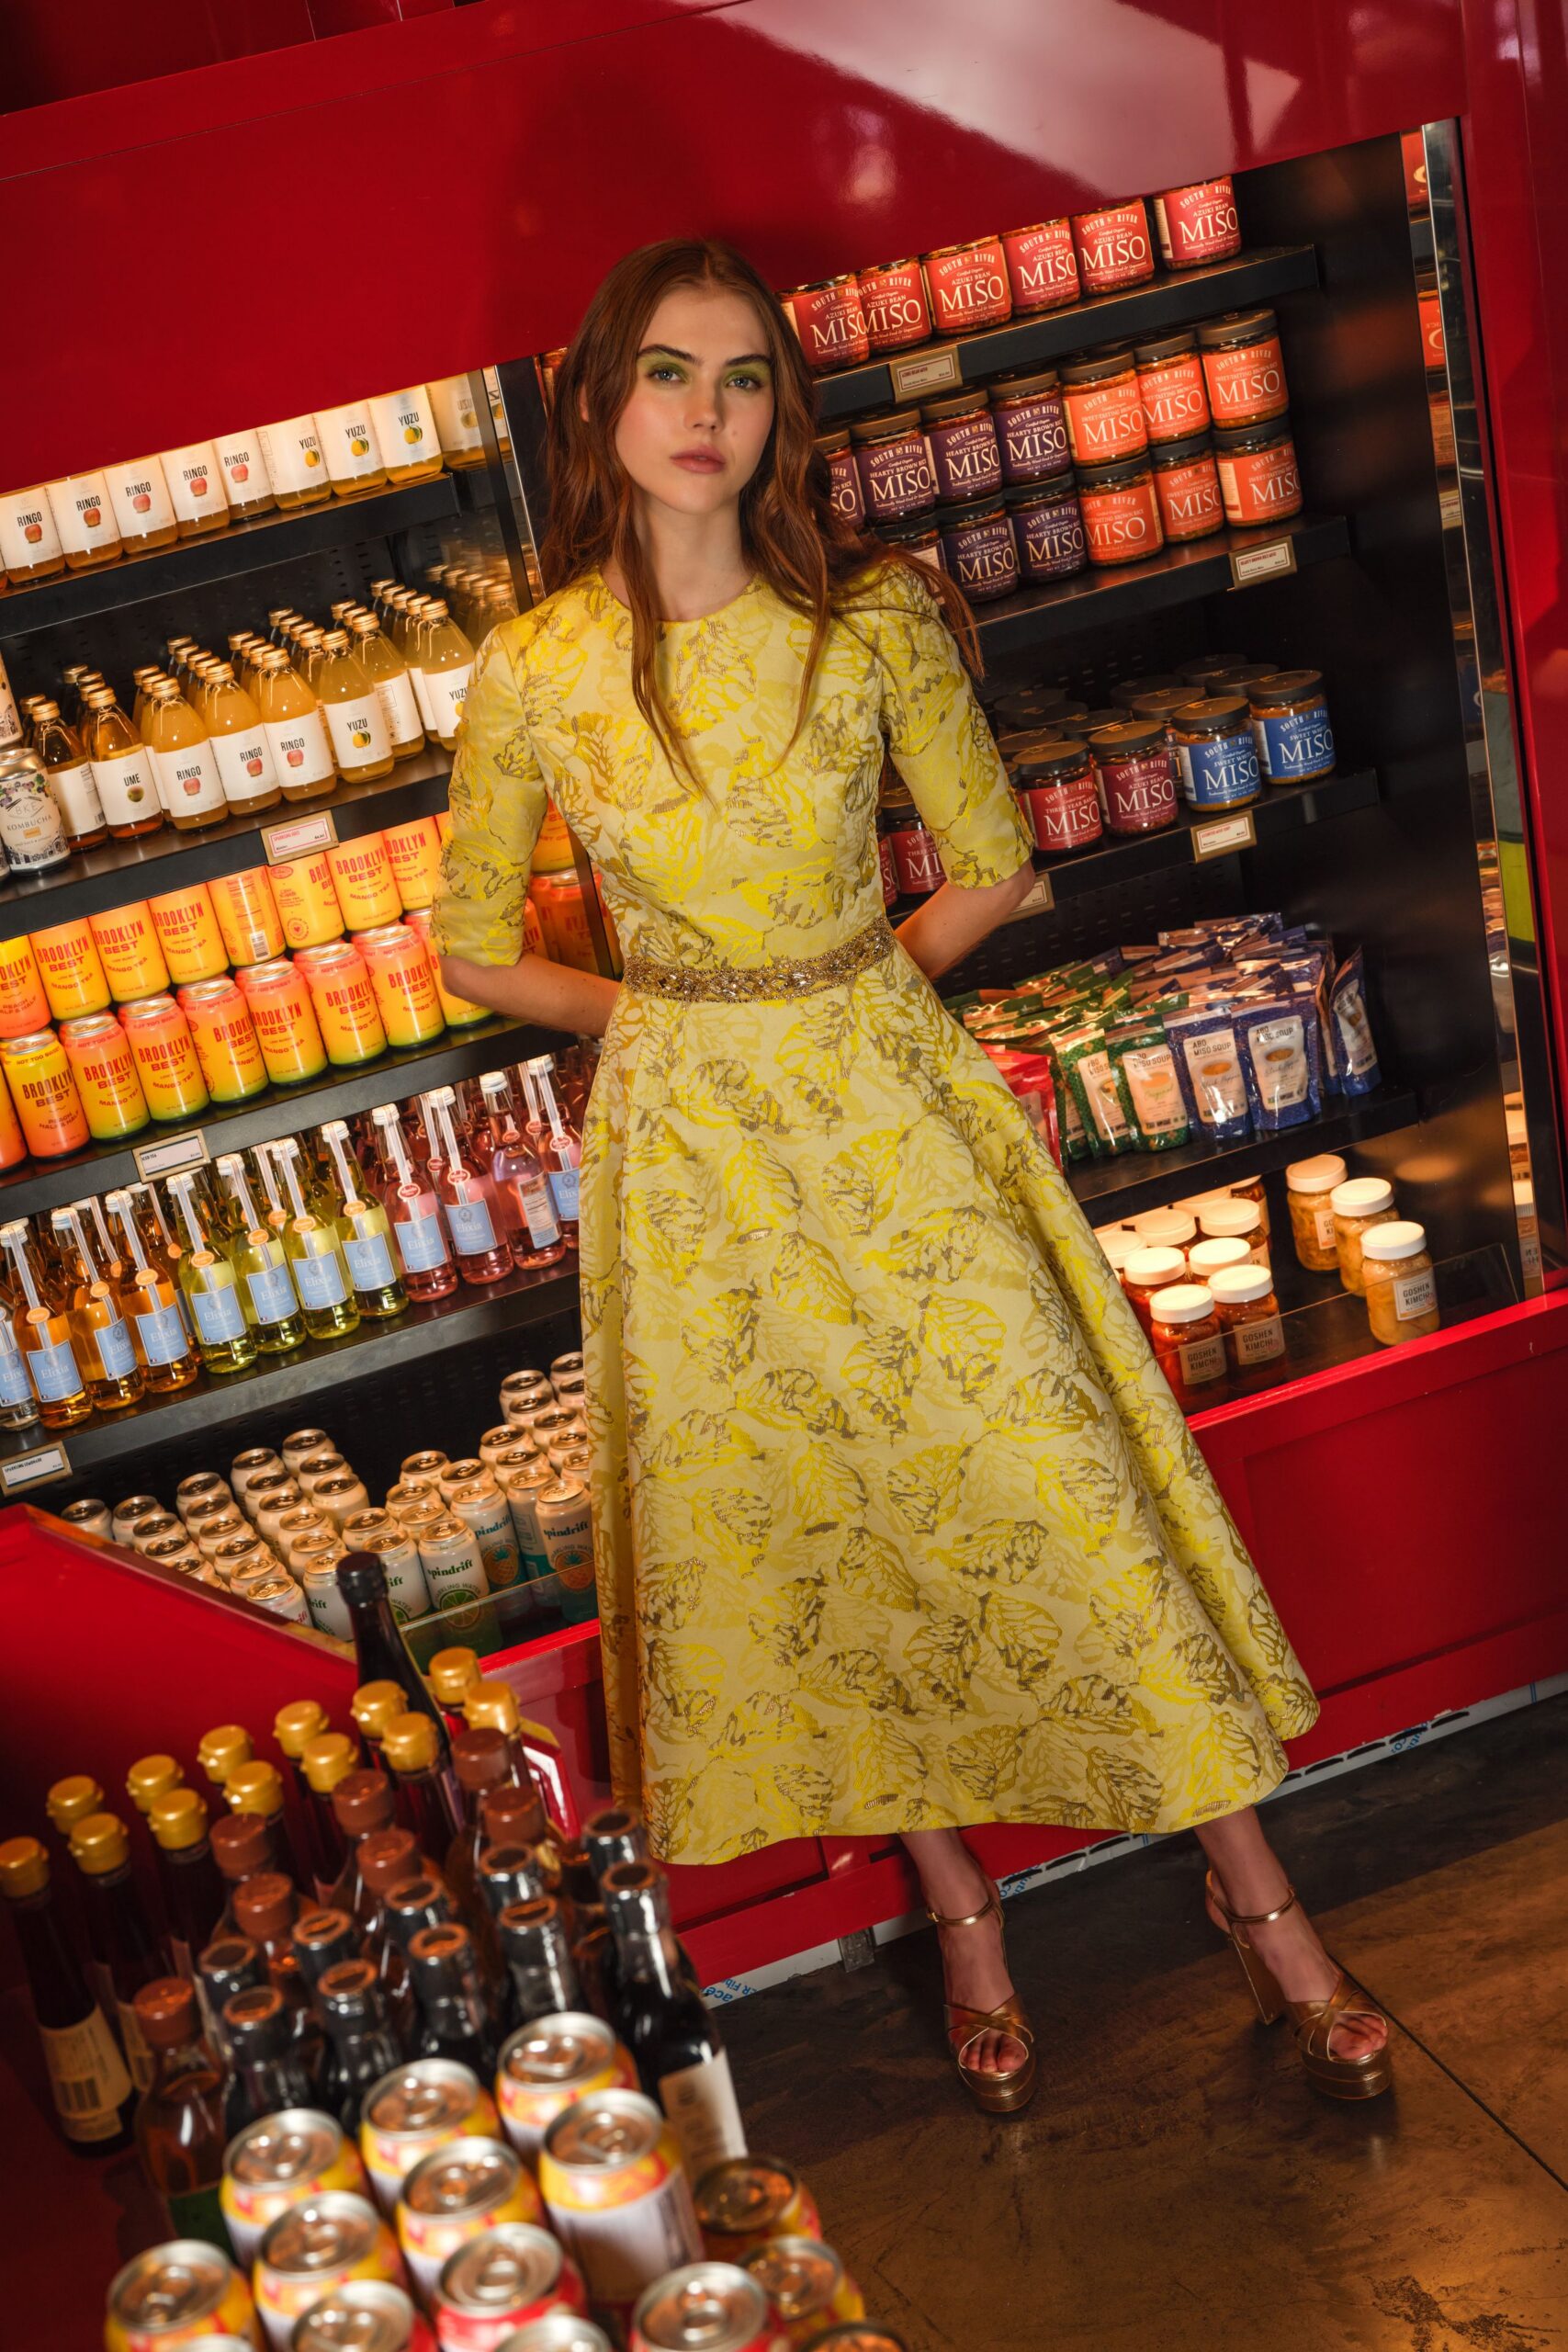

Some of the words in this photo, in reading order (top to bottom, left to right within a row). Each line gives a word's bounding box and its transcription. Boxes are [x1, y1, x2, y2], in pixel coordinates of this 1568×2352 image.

[1179, 190, 1204, 208] SOUTH
[1193, 208, 1214, 218] AZUKI
[1214, 202, 1229, 211] BEAN
[1081, 218, 1105, 235] SOUTH
[1117, 214, 1138, 223] RIVER
[1179, 207, 1238, 244] MISO
[1020, 234, 1043, 254] SOUTH
[1093, 235, 1115, 245] AZUKI
[1116, 231, 1133, 240] BEAN
[1032, 251, 1055, 262] AZUKI
[1055, 247, 1067, 255] BEAN
[1081, 236, 1145, 271] MISO
[939, 258, 963, 276] SOUTH
[975, 254, 994, 263] RIVER
[1018, 252, 1077, 289] MISO
[889, 277, 912, 287] RIVER
[952, 276, 973, 286] AZUKI
[975, 272, 990, 280] BEAN
[811, 292, 836, 311] SOUTH
[867, 298, 888, 308] AZUKI
[889, 295, 906, 303] BEAN
[938, 276, 1004, 311] MISO
[865, 300, 921, 333] MISO
[810, 311, 867, 347] MISO
[1216, 356, 1238, 371] SOUTH
[1251, 350, 1271, 358] RIVER
[1175, 369, 1194, 379] RIVER
[1216, 370, 1280, 404] MISO
[1083, 394, 1107, 411] SOUTH
[1142, 390, 1202, 424] MISO
[398, 413, 419, 425] YUZU
[1008, 411, 1031, 427] SOUTH
[1043, 405, 1059, 414] RIVER
[345, 424, 367, 438] YUZU
[1007, 428, 1032, 437] HEARTY
[1033, 424, 1054, 432] BROWN
[1082, 410, 1143, 445] MISO
[299, 436, 316, 449] YUZU
[946, 427, 970, 446] SOUTH
[1007, 427, 1066, 461] MISO
[224, 452, 249, 467] RINGO
[871, 449, 894, 467] SOUTH
[905, 445, 923, 454] RIVER
[945, 447, 971, 457] HEARTY
[945, 445, 999, 481] MISO
[1252, 454, 1274, 470] SOUTH
[183, 465, 207, 481] RINGO
[870, 468, 895, 479] HEARTY
[896, 463, 918, 472] BROWN
[1169, 470, 1192, 486] SOUTH
[126, 482, 152, 496] RINGO
[870, 466, 931, 501] MISO
[76, 496, 101, 511] RINGO
[17, 512, 42, 527] RINGO
[1027, 512, 1051, 528] SOUTH
[1061, 507, 1077, 516] RIVER
[958, 532, 981, 548] SOUTH
[992, 527, 1007, 536] RIVER
[1026, 530, 1051, 539] HEARTY
[1026, 527, 1083, 562] MISO
[957, 551, 982, 560] HEARTY
[957, 548, 1014, 582] MISO
[347, 718, 367, 731] YUZU
[1280, 716, 1303, 731] SOUTH
[1290, 730, 1311, 741] SWEET
[281, 739, 305, 752] RINGO
[1205, 742, 1228, 758] SOUTH
[1279, 729, 1333, 764] MISO
[240, 747, 263, 762] RINGO
[1213, 758, 1235, 767] SWEET
[177, 766, 201, 780] RINGO
[1116, 764, 1139, 781] SOUTH
[1151, 761, 1167, 769] RIVER
[1204, 755, 1259, 790] MISO
[124, 774, 141, 786] UME
[1129, 781, 1148, 789] AZUKI
[1150, 775, 1164, 785] BEAN
[1045, 787, 1068, 804] SOUTH
[1115, 779, 1174, 813] MISO
[6, 815, 52, 831] KOMBUCHA
[1044, 800, 1100, 836] MISO
[335, 847, 386, 875] BROOKLYN
[348, 866, 382, 882] BEST
[350, 892, 378, 900] MANGO
[379, 883, 389, 894] TEA
[95, 921, 144, 945] BROOKLYN
[164, 922, 197, 936] BEST
[37, 935, 90, 963] BROOKLYN
[104, 940, 138, 954] BEST
[194, 939, 206, 949] TEA
[50, 956, 85, 971] BEST
[134, 957, 147, 967] TEA
[0, 976, 27, 990] EST
[51, 981, 80, 989] MANGO
[82, 973, 93, 983] TEA
[403, 978, 430, 995] BEST
[340, 997, 371, 1014] BEST
[262, 1023, 296, 1035] BEST
[230, 1032, 254, 1048] BEST
[1193, 1039, 1206, 1048] ABO
[139, 1035, 191, 1063] BROOKLYN
[1194, 1046, 1211, 1057] MISO
[1213, 1042, 1231, 1051] SOUP
[84, 1054, 133, 1081] BROOKLYN
[152, 1055, 186, 1071] BEST
[1153, 1055, 1170, 1065] SOUP
[22, 1069, 73, 1099] BROOKLYN
[98, 1072, 131, 1089] BEST
[183, 1072, 195, 1082] TEA
[36, 1089, 71, 1107] BEST
[99, 1098, 127, 1106] MANGO
[456, 1222, 482, 1232] Elixia
[409, 1238, 434, 1250] Elixia
[354, 1260, 381, 1269] Elixia
[261, 1288, 286, 1300] Elixia
[1403, 1283, 1430, 1297] GOSHEN
[151, 1329, 176, 1342] Elixia
[1243, 1329, 1272, 1341] GOSHEN
[1188, 1348, 1216, 1361] GOSHEN
[41, 1365, 69, 1378] Elixia
[544, 1521, 588, 1540] spindrift
[429, 1559, 473, 1578] spindrift
